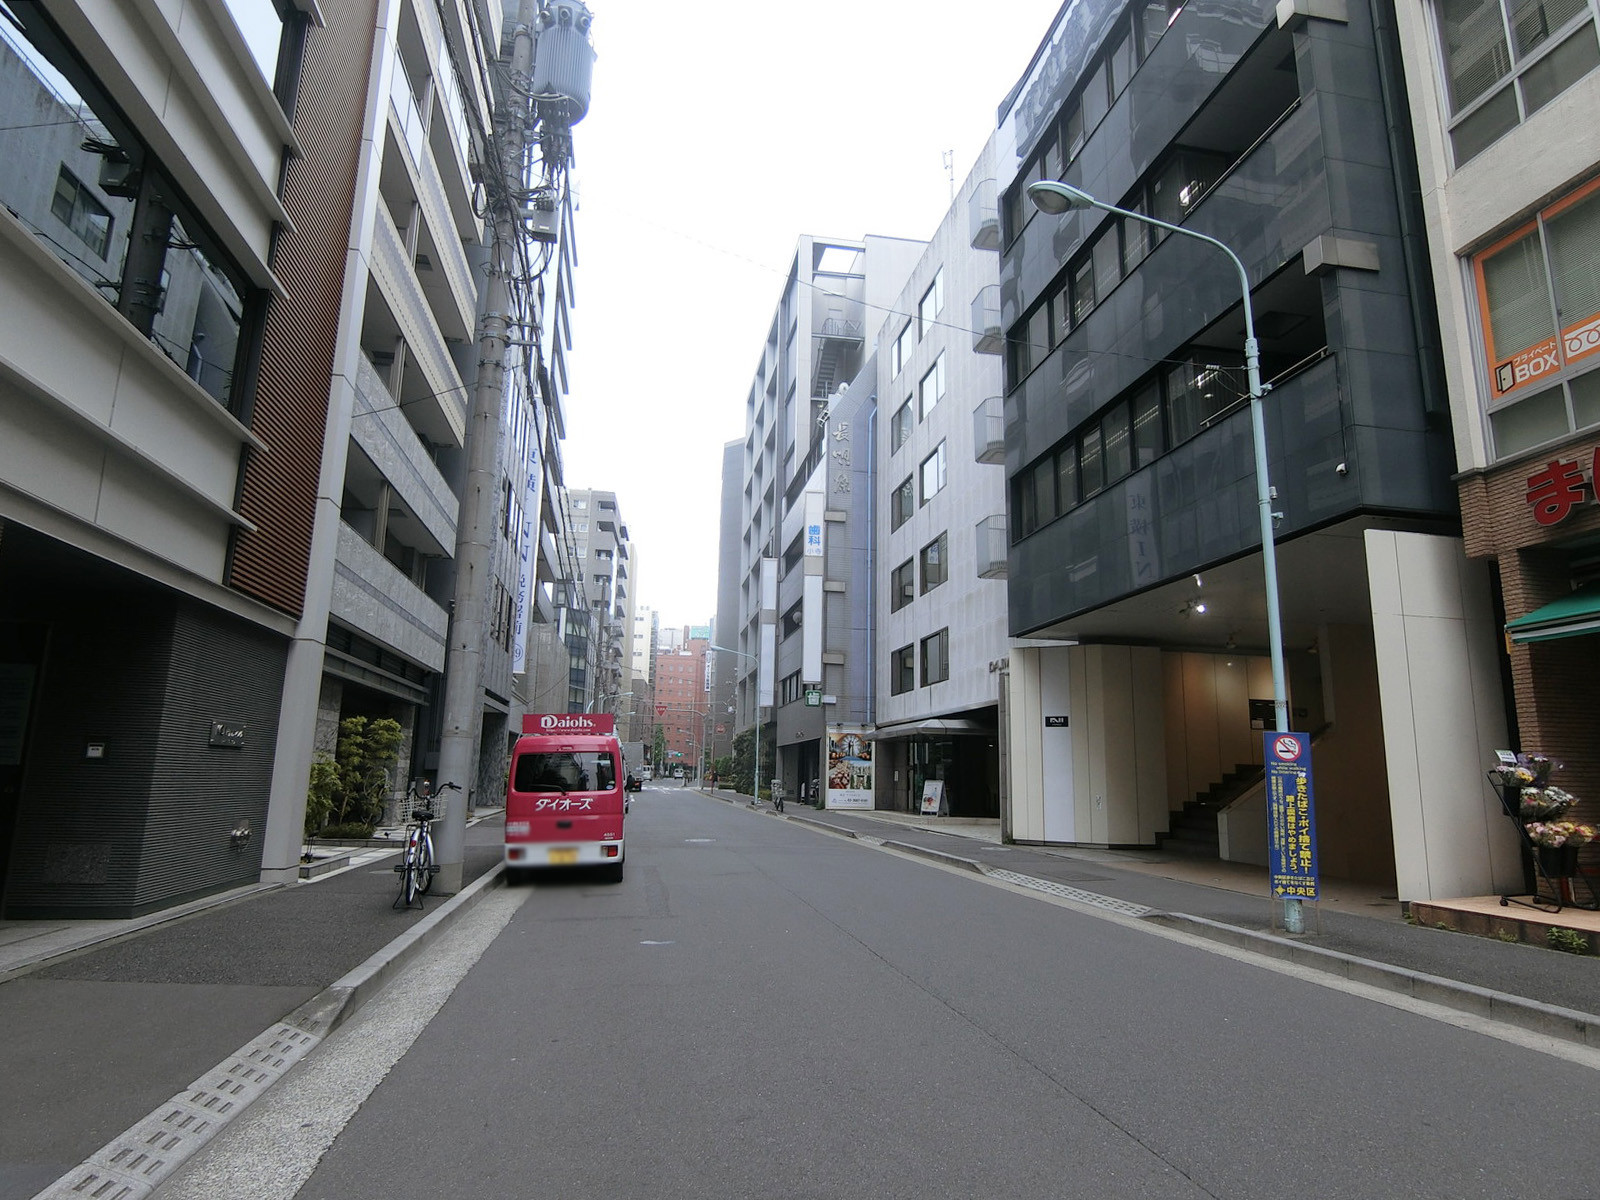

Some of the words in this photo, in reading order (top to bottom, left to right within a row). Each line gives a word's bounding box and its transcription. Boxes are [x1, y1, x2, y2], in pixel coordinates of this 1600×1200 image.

[1515, 350, 1559, 383] BOX
[1526, 446, 1600, 527] ま
[808, 524, 821, 546] 歯科
[541, 714, 594, 729] Daiohs
[535, 798, 594, 812] ダイオーズ
[1286, 885, 1317, 897] 中央区
